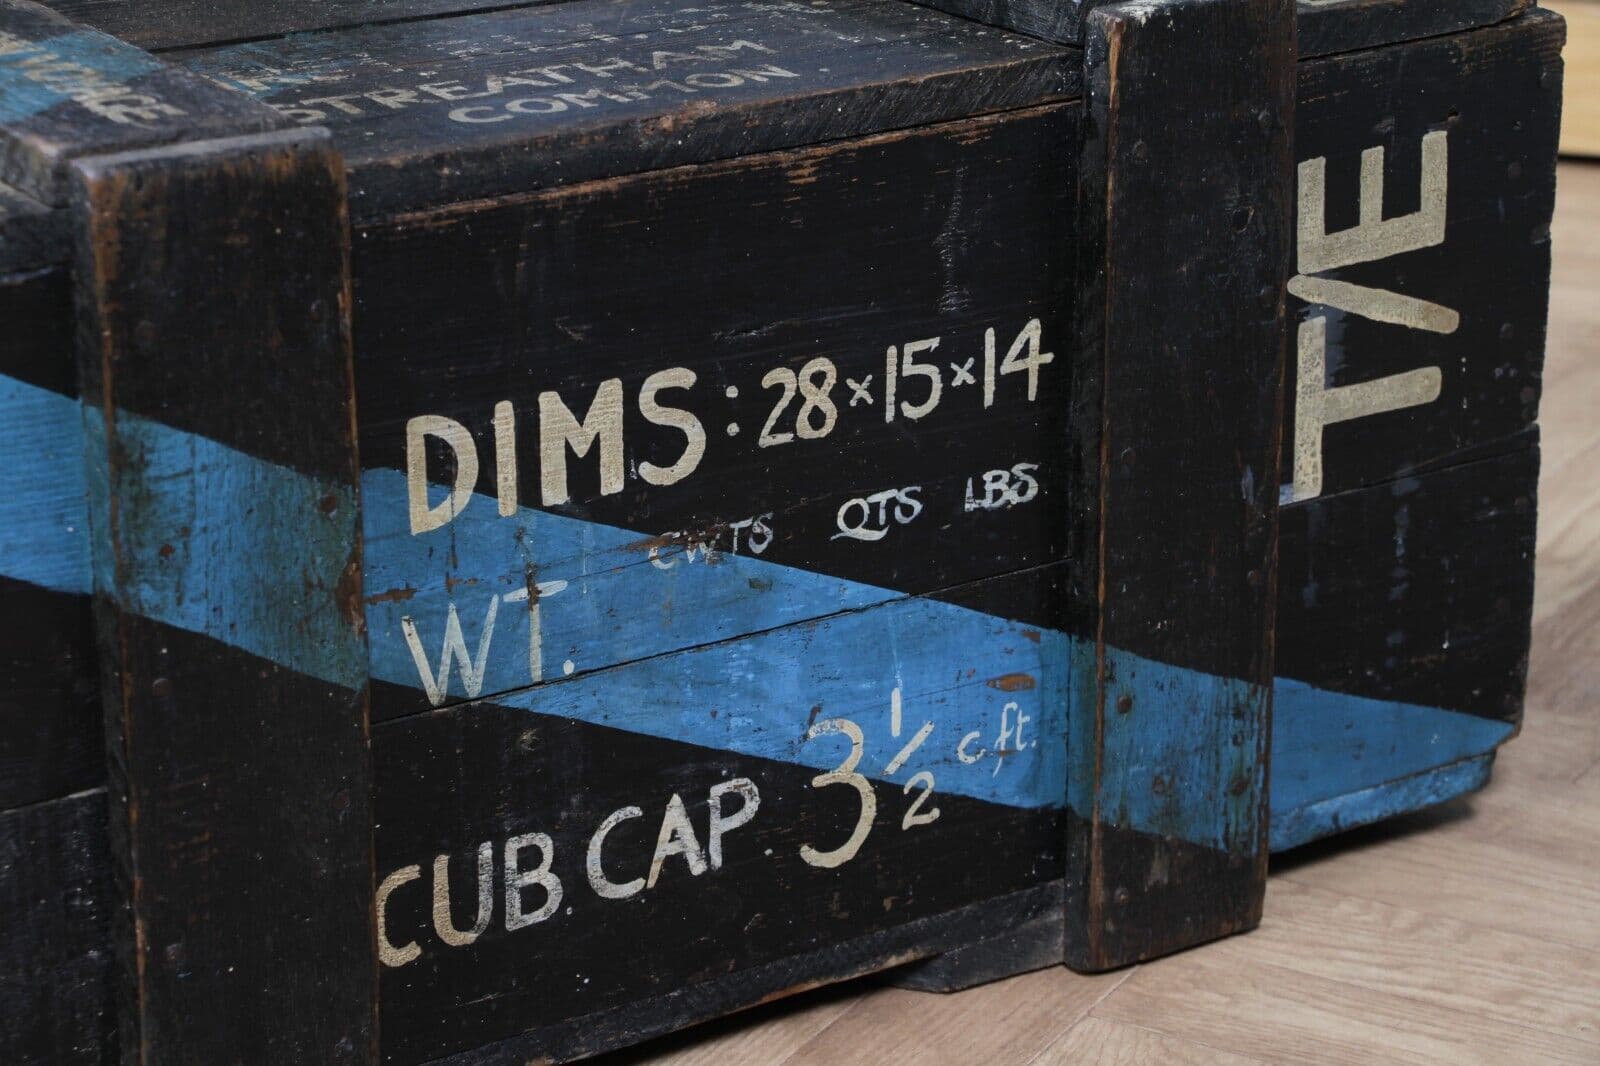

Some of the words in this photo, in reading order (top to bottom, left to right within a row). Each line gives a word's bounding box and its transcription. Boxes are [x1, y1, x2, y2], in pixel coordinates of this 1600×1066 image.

[449, 63, 799, 124] COMMON
[829, 485, 923, 543] QTS
[964, 462, 1041, 513] LBS
